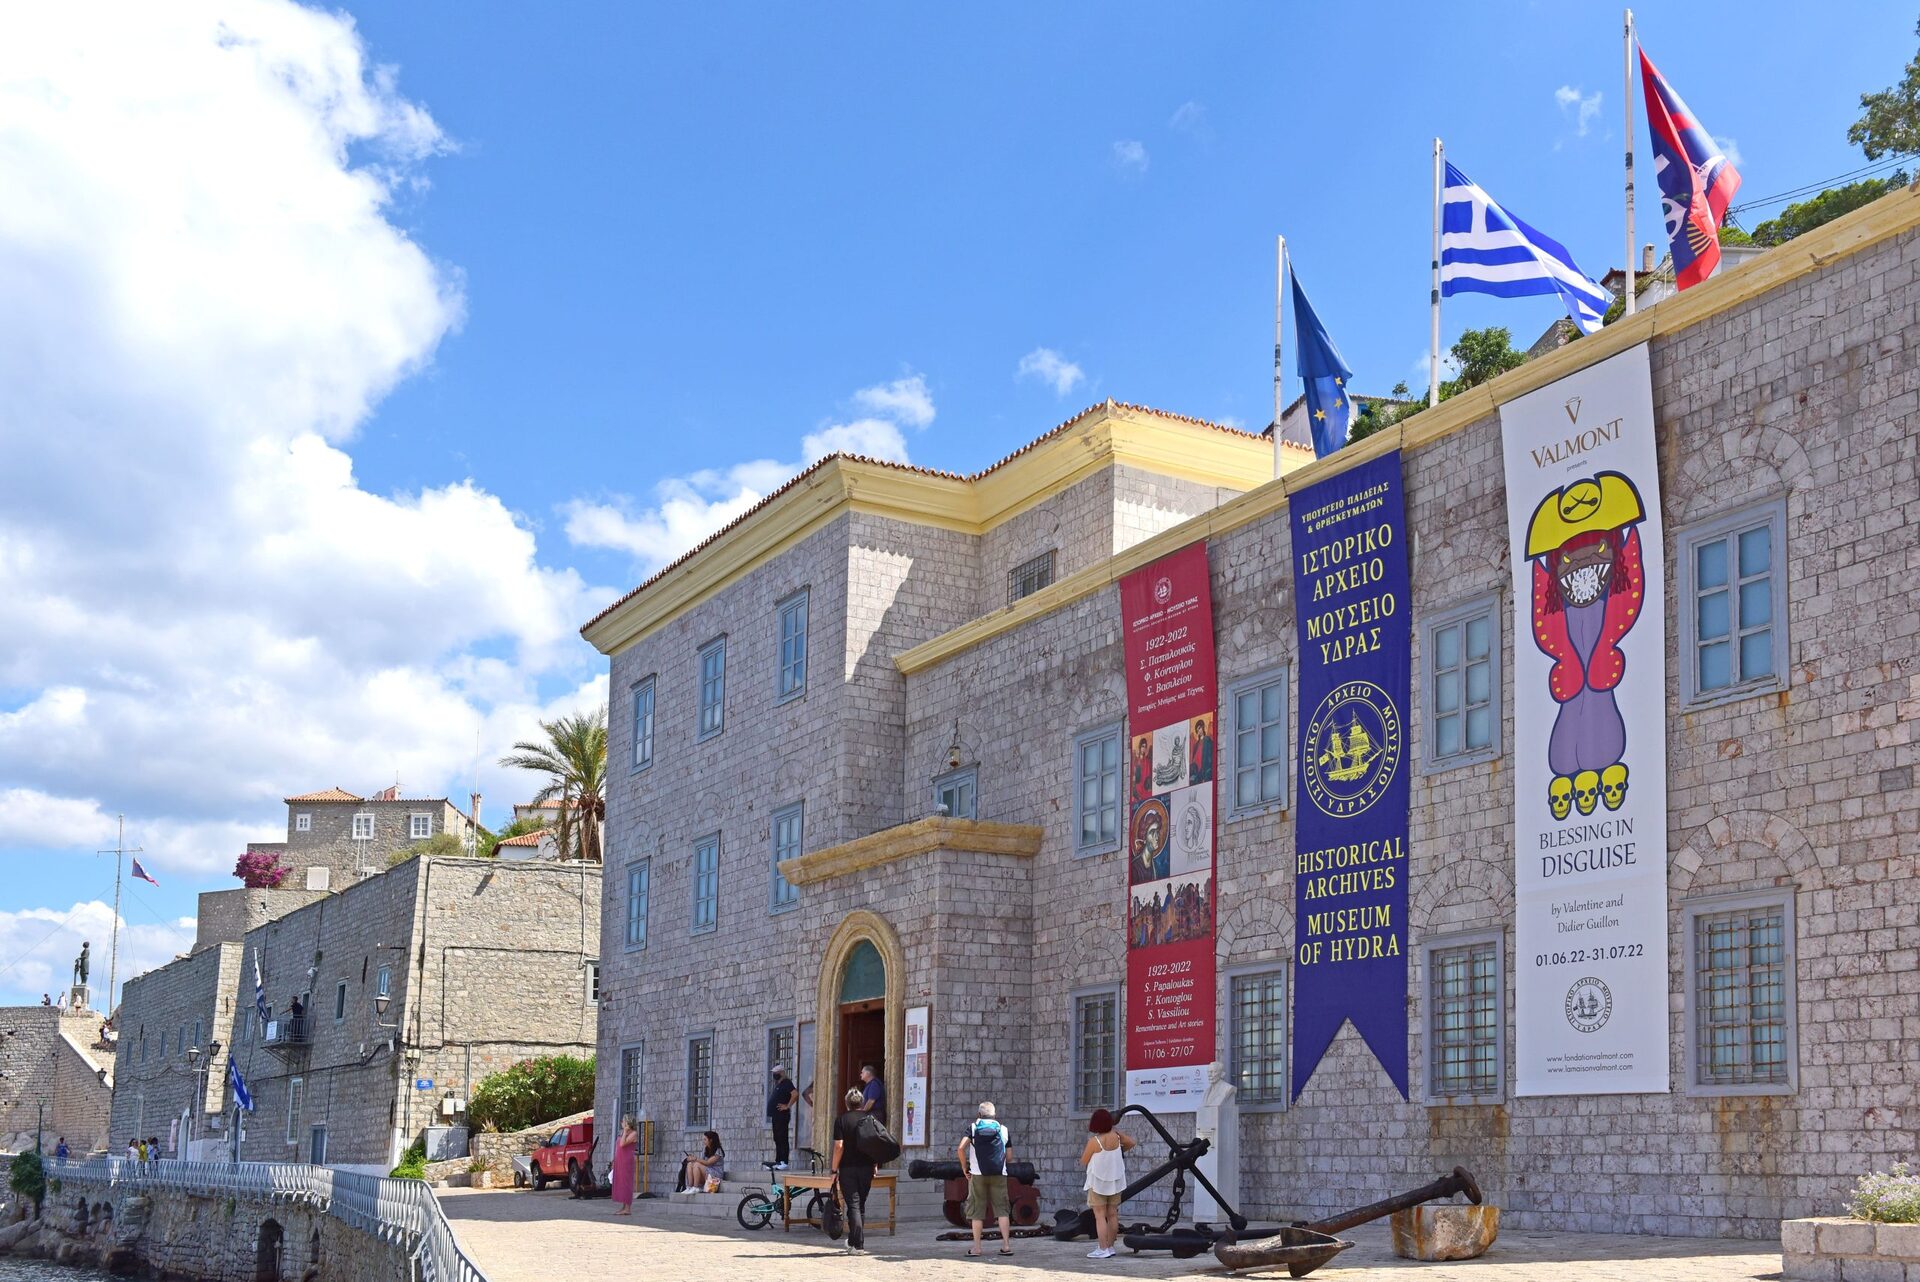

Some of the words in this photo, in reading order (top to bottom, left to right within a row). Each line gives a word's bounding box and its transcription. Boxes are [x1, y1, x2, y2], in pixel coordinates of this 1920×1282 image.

[1531, 418, 1623, 469] VALMONT
[1566, 460, 1587, 472] presents
[1302, 500, 1344, 523] ΥΠΟΥΡΓΕΙΟ
[1347, 482, 1389, 505] ΠΑΙΔΕΙΑΣ
[1315, 497, 1383, 530] ΘΡΗΣΚΕΥΜΑΤΩΝ
[1302, 523, 1393, 576] ΙΣΤΟΡΙΚΟ
[1313, 558, 1384, 602] ΑΡΧΕΙΟ
[1307, 593, 1395, 641] ΜΟΥΣΕΙΟ
[1146, 626, 1188, 651] 1922-2022
[1320, 627, 1381, 665] ΥΔΡΑΣ
[1327, 686, 1372, 709] ΑΡΧΕΙΟ
[1306, 722, 1323, 801] ΙΣΤΟΡΙΚΟ
[1379, 705, 1397, 785] ΜΟΥΣΕΙΟ
[1328, 787, 1377, 813] ΥΔΡΑΣ
[1539, 821, 1612, 850] BLESSING
[1616, 817, 1634, 836] IN
[1297, 837, 1405, 875] HISTORICAL
[1541, 842, 1637, 878] DISGUISE
[1304, 866, 1395, 900] ARCHIVES
[1307, 904, 1391, 936] MUSEUM
[1551, 903, 1561, 918] by
[1563, 899, 1604, 914] Valentine
[1605, 894, 1624, 908] and
[1557, 919, 1585, 933] Didier
[1586, 915, 1620, 931] Guillon
[1300, 941, 1322, 966] OF
[1330, 933, 1400, 962] HYDRA
[1148, 961, 1191, 977] 1922-2022
[1153, 977, 1194, 993] Papaloukas
[1155, 993, 1192, 1006] Kontoglou
[1157, 1006, 1190, 1018] Vassiliou
[1168, 1021, 1177, 1029] and
[1144, 1048, 1166, 1060] 11/06
[1170, 1045, 1194, 1057] 27/07
